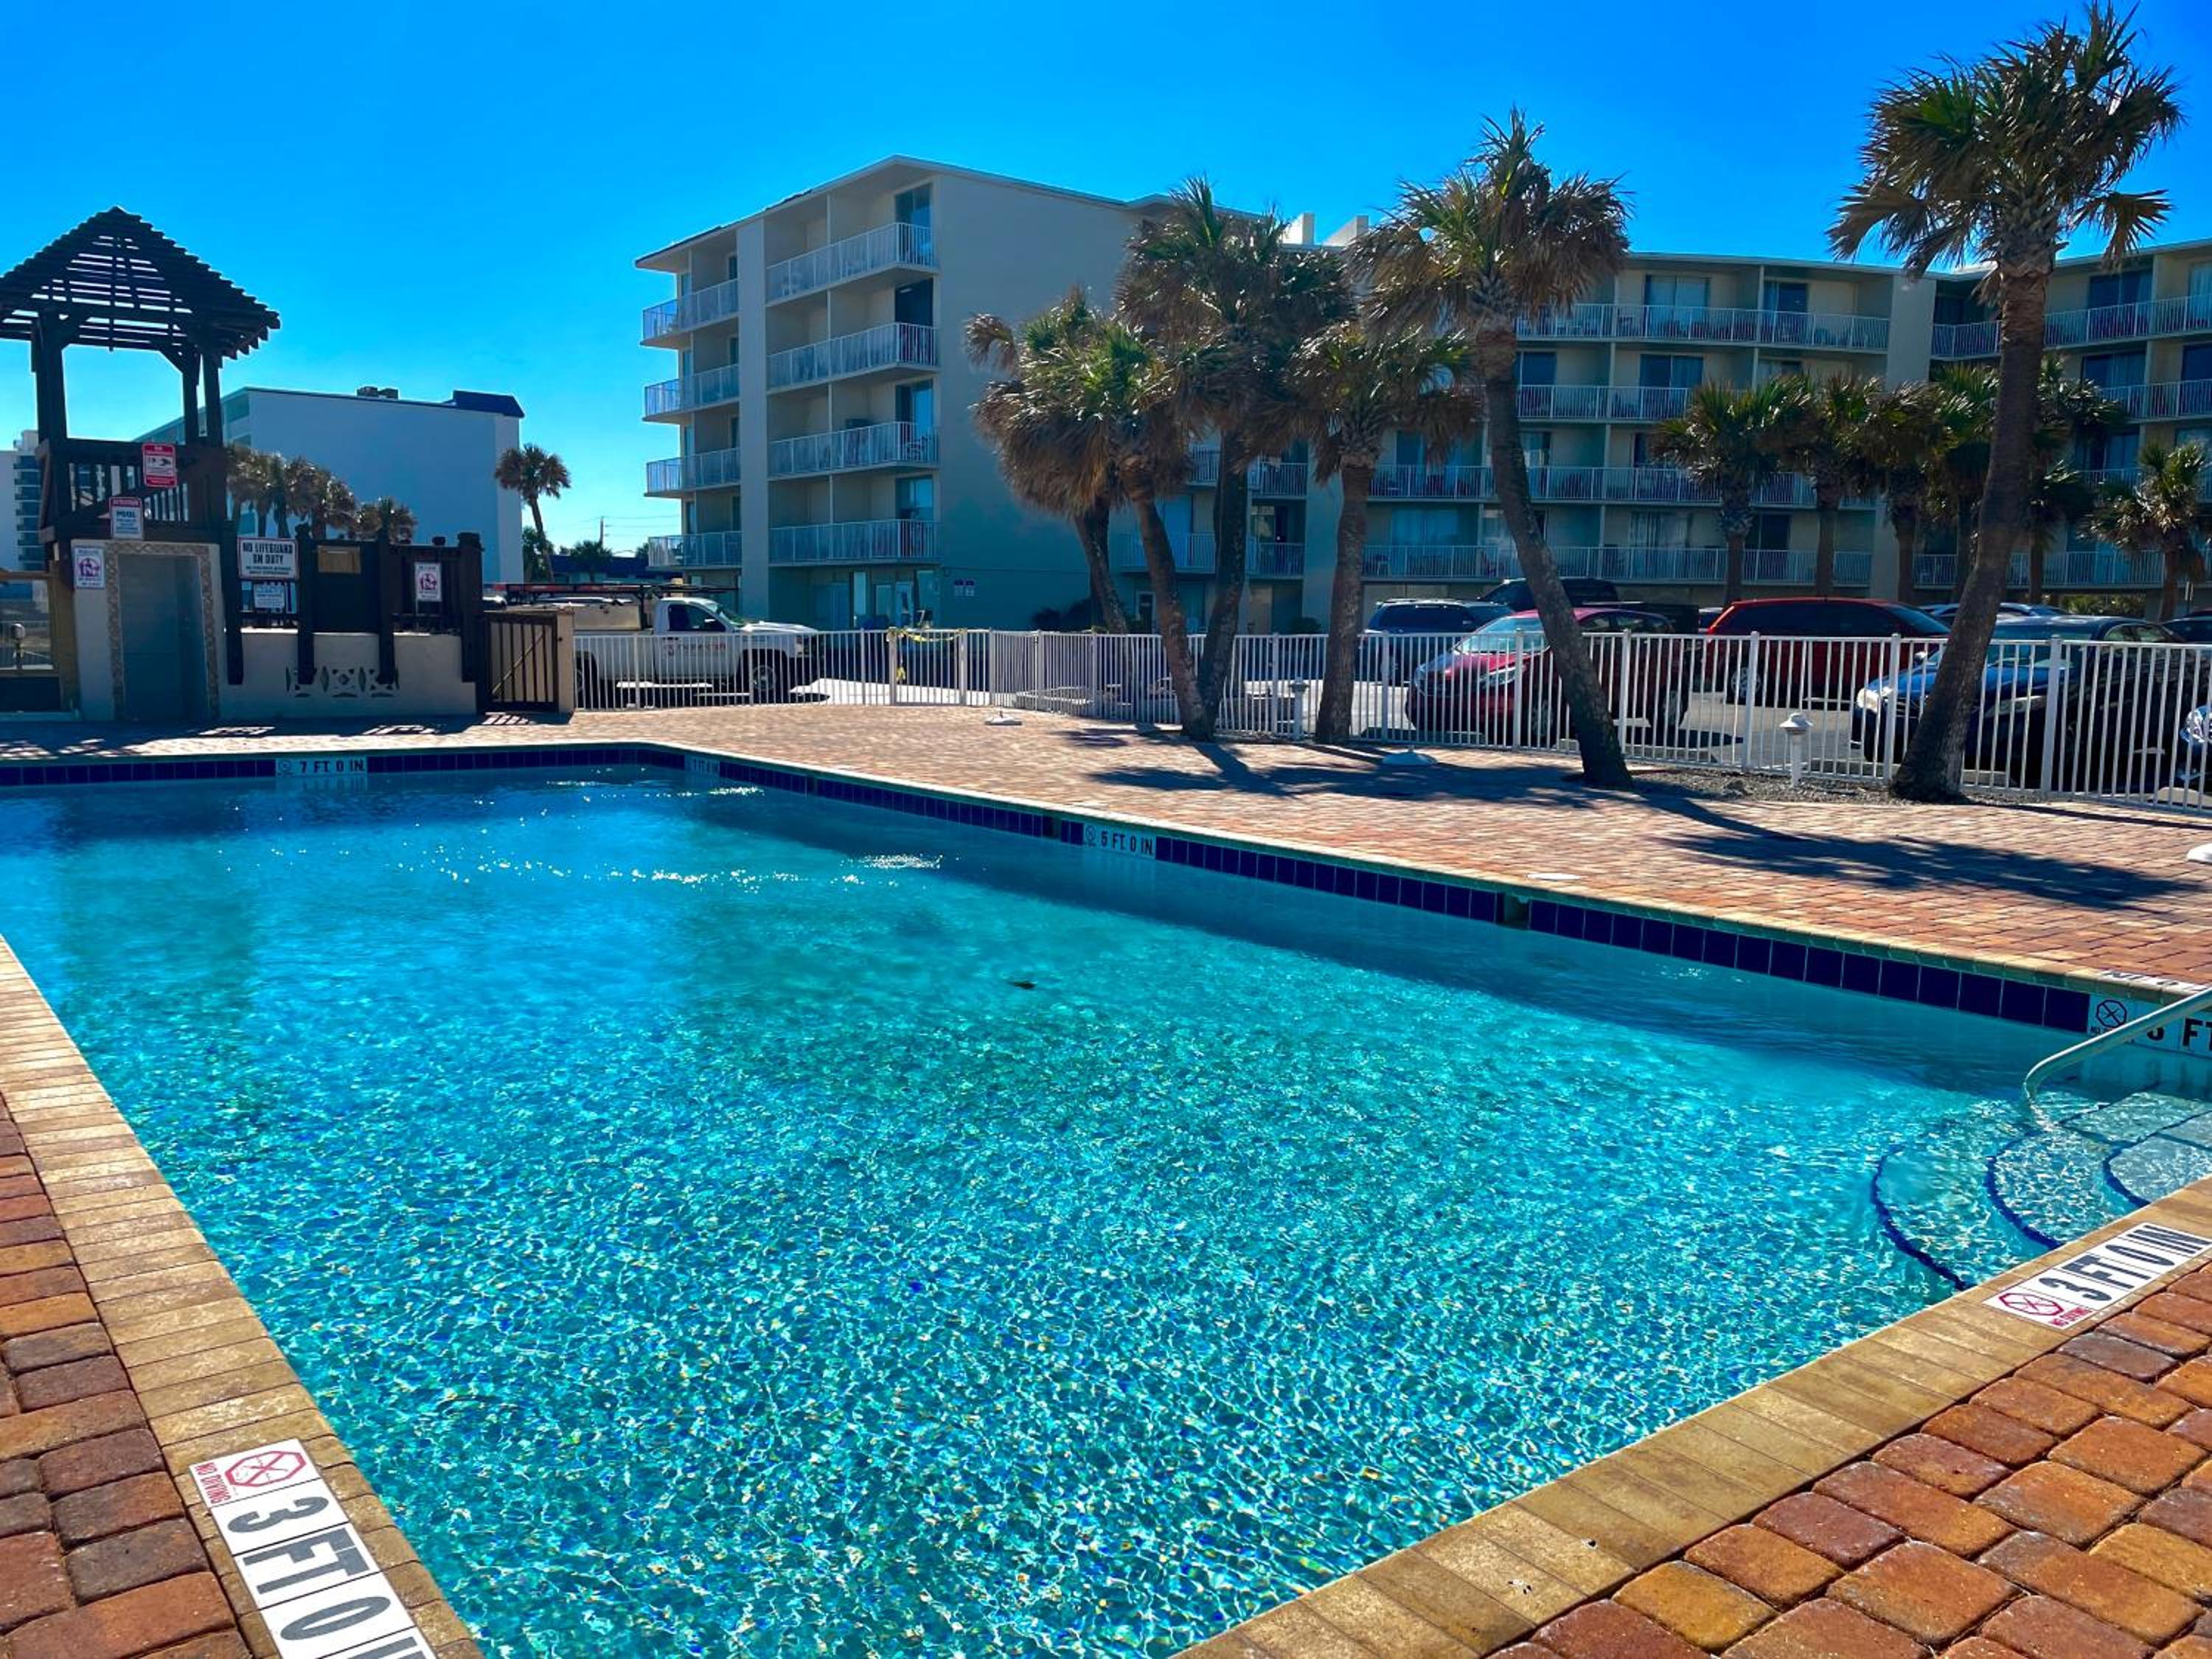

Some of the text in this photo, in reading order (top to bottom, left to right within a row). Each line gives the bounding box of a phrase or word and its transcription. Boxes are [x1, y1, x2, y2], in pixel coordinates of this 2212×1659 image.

[243, 542, 293, 554] NO LIFEGUARD
[253, 554, 284, 565] ON DUTY
[299, 760, 307, 773] 7
[2038, 1224, 2212, 1301] 3 FT 0 IN
[194, 1462, 231, 1503] NO DIVING
[227, 1496, 330, 1533] 3
[242, 1527, 370, 1595] FT
[279, 1596, 392, 1641] 0
